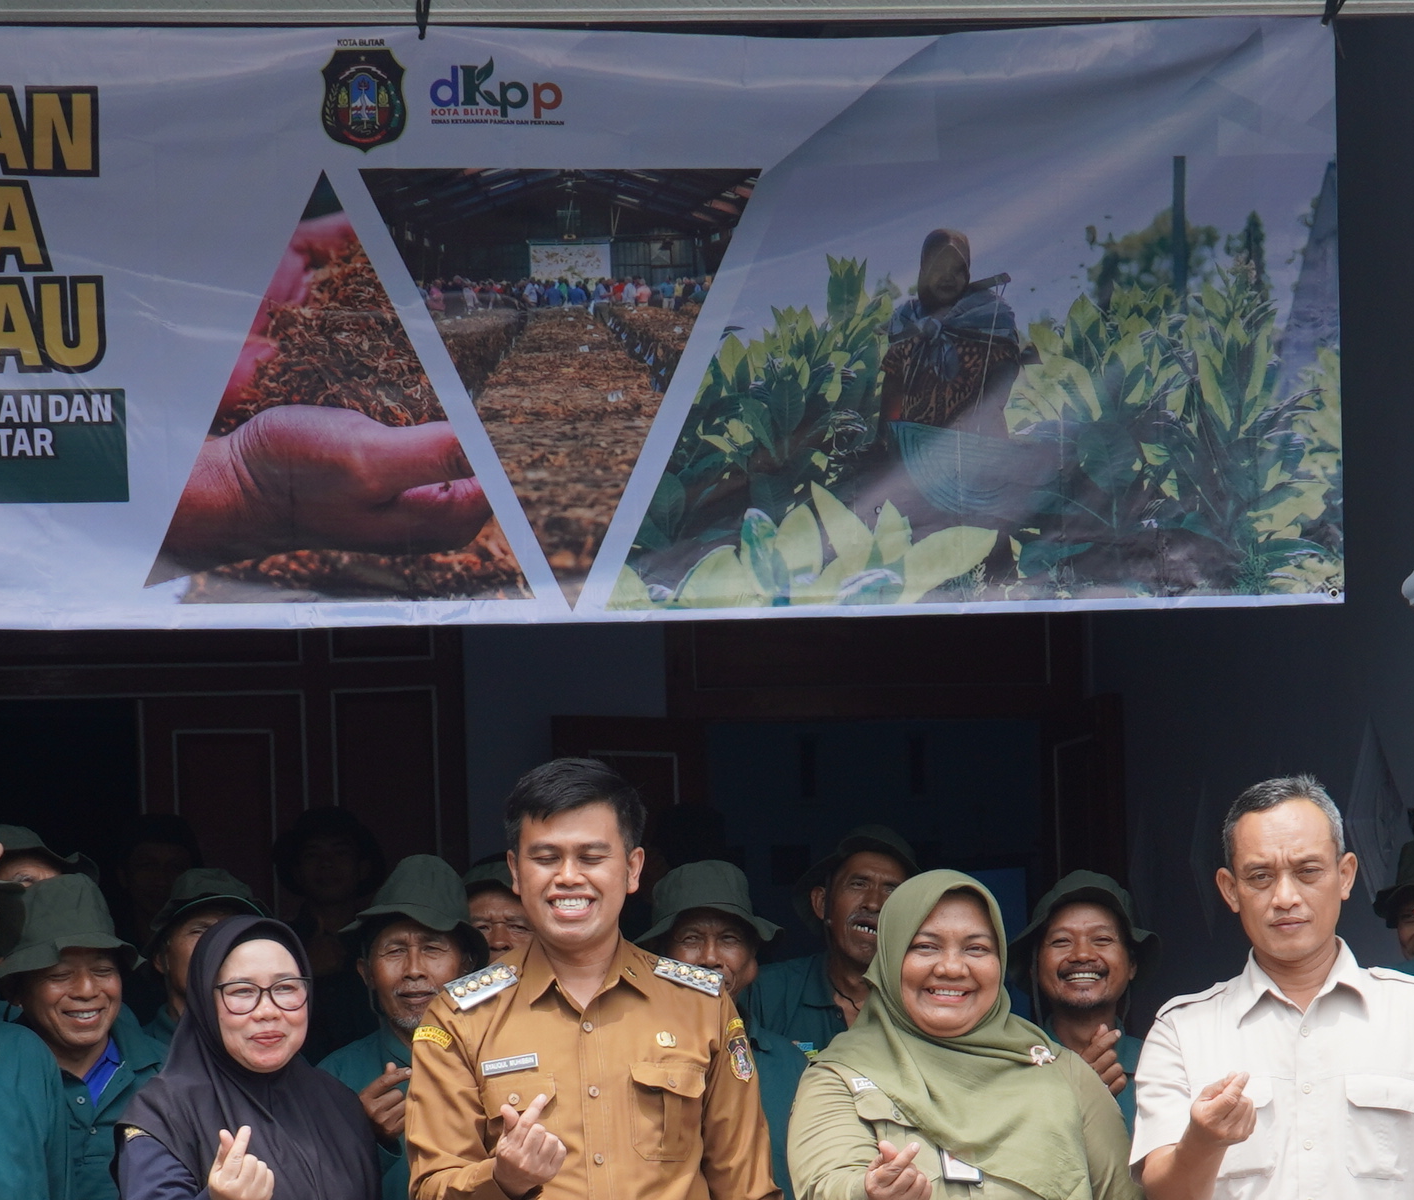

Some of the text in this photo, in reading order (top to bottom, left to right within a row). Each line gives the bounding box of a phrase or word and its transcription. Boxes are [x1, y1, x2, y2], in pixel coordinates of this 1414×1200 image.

[337, 38, 385, 46] KOTA BLITAR
[431, 108, 499, 117] KOTA BLITAR
[48, 395, 113, 425] DAN
